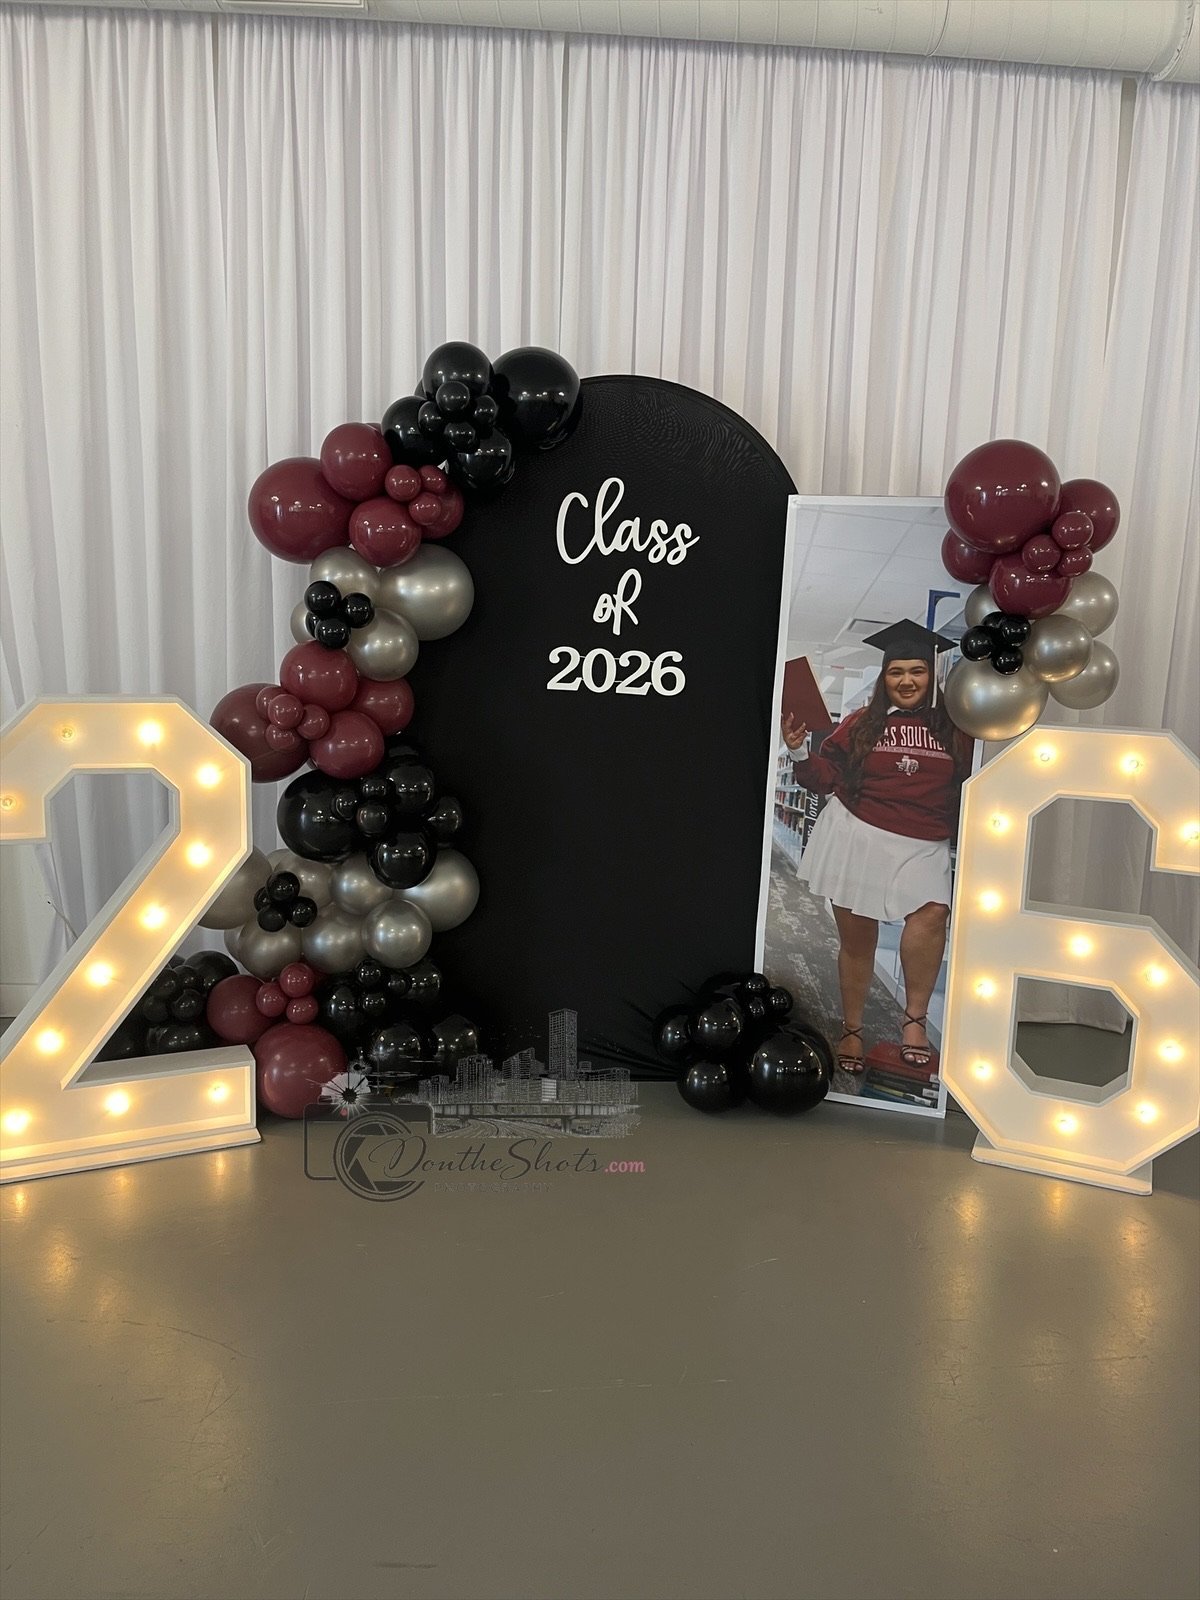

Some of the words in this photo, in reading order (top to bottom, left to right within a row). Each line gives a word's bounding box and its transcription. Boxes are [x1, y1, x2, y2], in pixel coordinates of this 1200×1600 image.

[556, 477, 700, 566] Class
[546, 646, 686, 696] 2026
[876, 726, 897, 748] AS
[0, 694, 257, 1168] 2
[942, 727, 1200, 1176] 6
